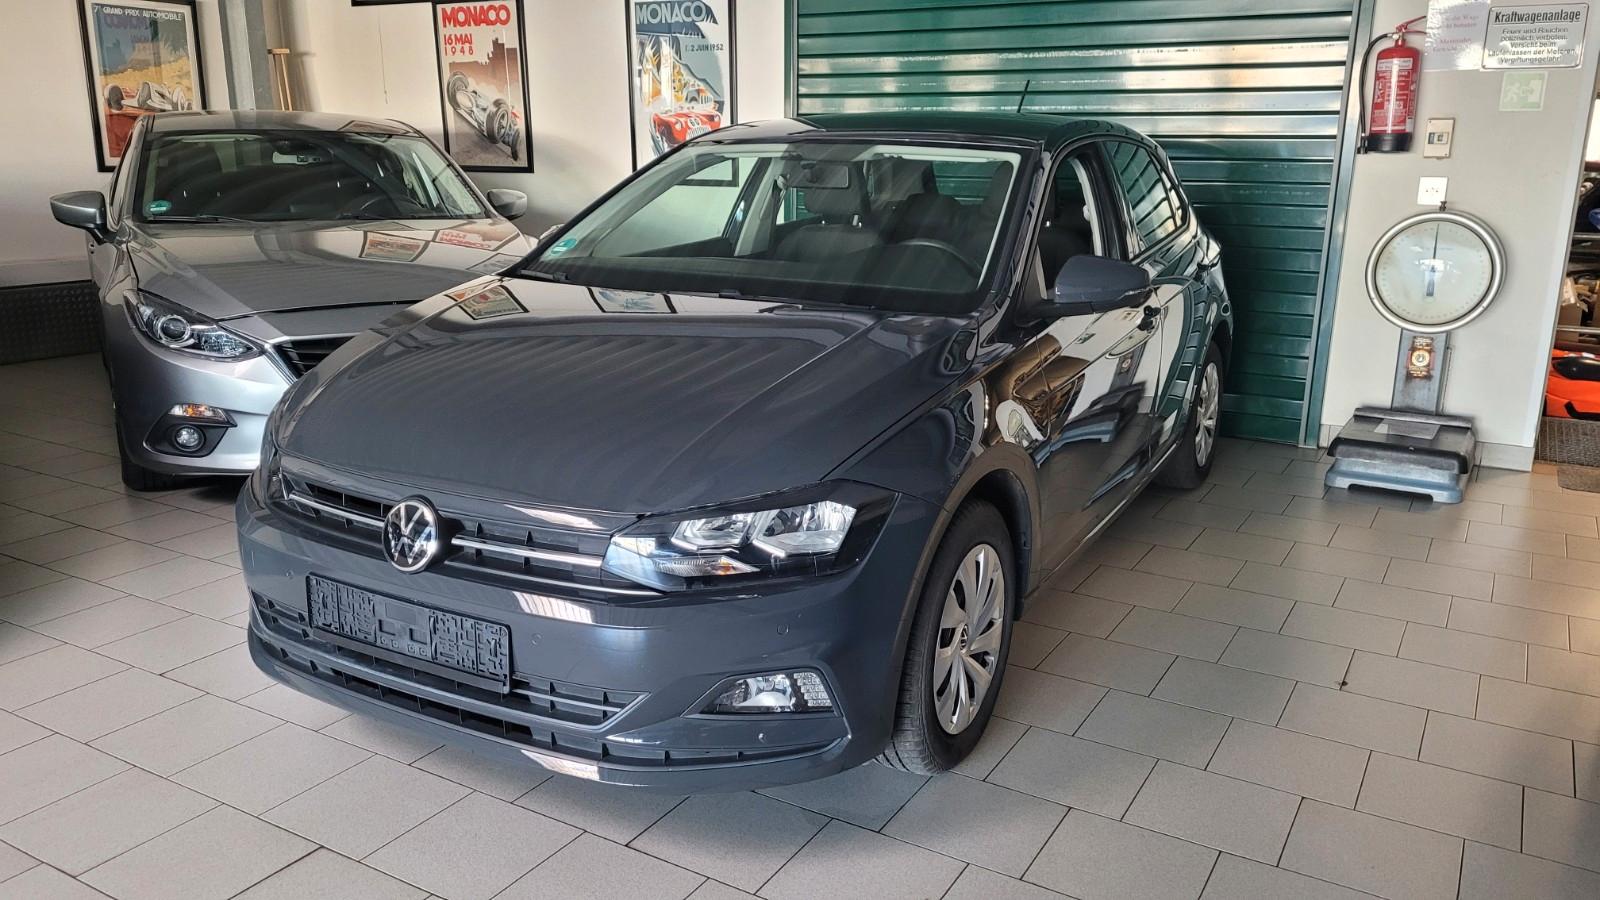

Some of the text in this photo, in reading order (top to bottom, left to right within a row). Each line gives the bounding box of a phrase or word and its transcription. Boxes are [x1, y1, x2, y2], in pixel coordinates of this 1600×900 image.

[102, 6, 122, 15] GRAND
[125, 8, 140, 17] PRIX
[142, 11, 182, 20] AUTOMOBILE
[441, 5, 511, 28] MONACO
[636, 1, 706, 24] MONACO
[1494, 9, 1581, 25] Kraftwagenanlage
[443, 33, 473, 46] 16 MAI
[444, 46, 474, 56] 1948
[709, 43, 724, 51] 1952
